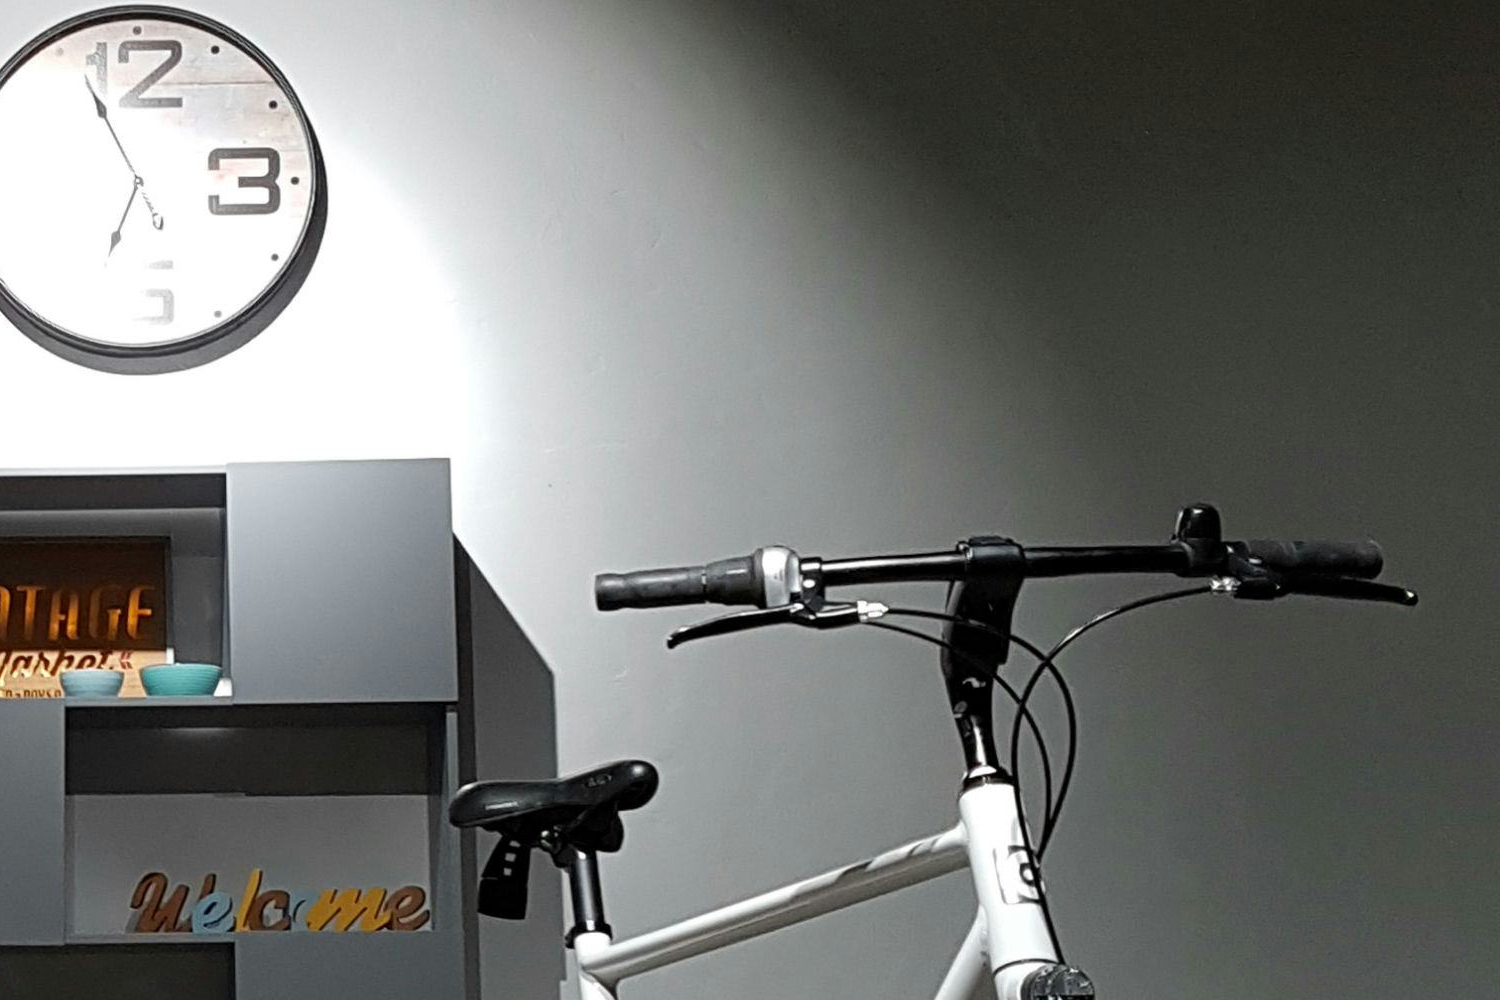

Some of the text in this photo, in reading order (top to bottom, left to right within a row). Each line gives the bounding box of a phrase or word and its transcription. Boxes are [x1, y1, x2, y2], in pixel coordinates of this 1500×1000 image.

[85, 39, 183, 109] 12
[207, 147, 281, 216] 3
[129, 868, 432, 934] Welcome
